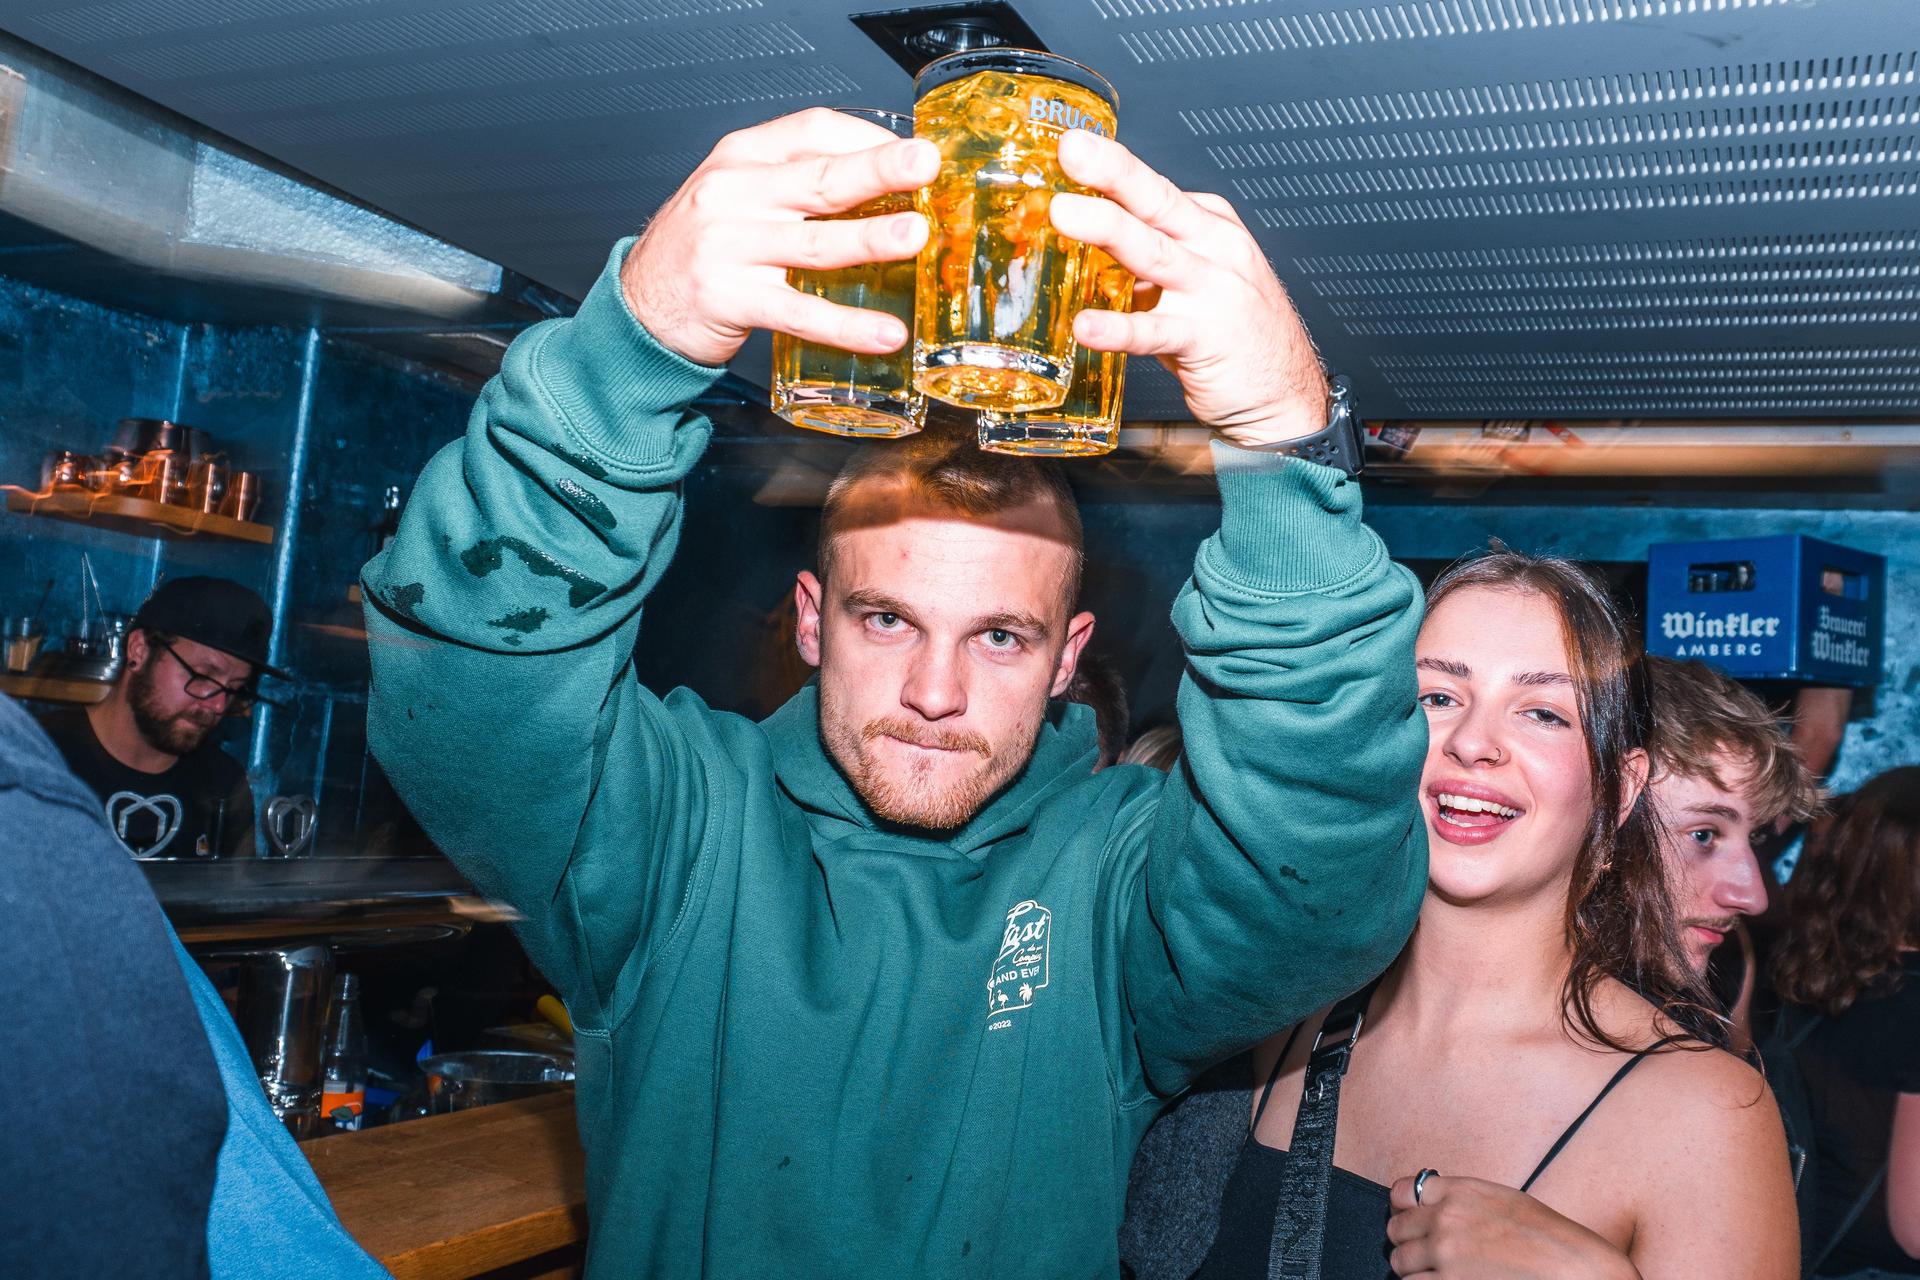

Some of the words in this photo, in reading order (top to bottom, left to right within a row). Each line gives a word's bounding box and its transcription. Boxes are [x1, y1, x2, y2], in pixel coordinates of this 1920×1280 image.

[1661, 612, 1780, 639] Winkler
[1676, 643, 1762, 657] AMBERG
[1812, 631, 1870, 666] Winkler
